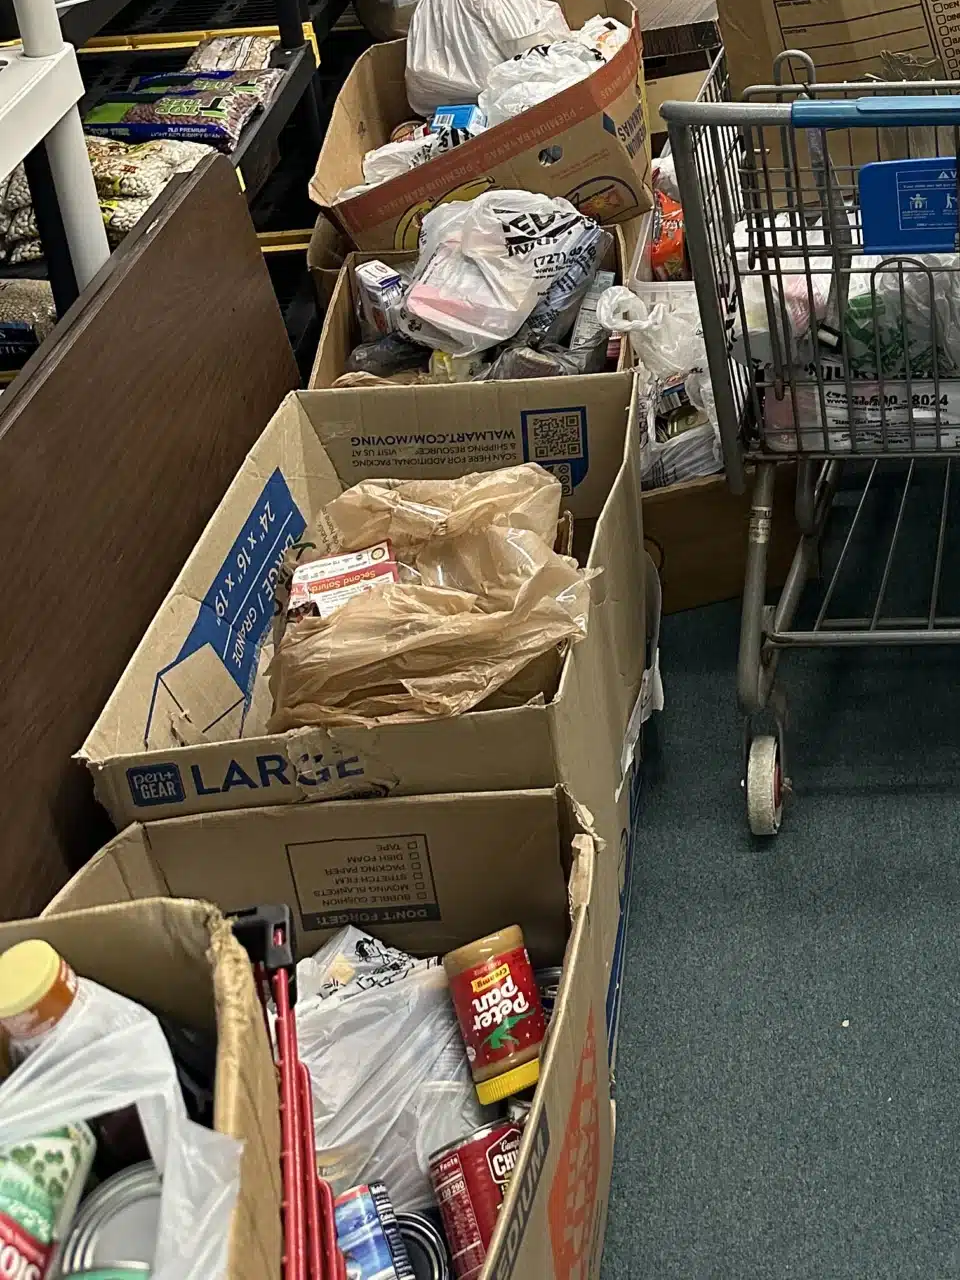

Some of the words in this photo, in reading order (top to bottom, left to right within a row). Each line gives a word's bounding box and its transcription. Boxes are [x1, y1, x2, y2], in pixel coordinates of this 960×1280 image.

[944, 0, 960, 10] DEN
[534, 252, 567, 268] (727)
[911, 394, 948, 406] 8024
[350, 429, 516, 447] WALMART.COM/MOVING
[351, 449, 362, 457] AT
[364, 449, 375, 457] US
[377, 448, 397, 456] VISIT
[467, 444, 509, 453] SHIPPING
[392, 458, 447, 466] ADDITIONAL
[447, 456, 466, 465] FOR
[467, 454, 491, 463] HERE
[492, 453, 517, 461] SCAN
[352, 459, 391, 468] PACKING
[343, 570, 376, 586] Second
[302, 579, 341, 595] Saturdy
[232, 606, 258, 669] GRANDE
[133, 771, 175, 790] pen+
[140, 782, 177, 799] GEAR
[376, 843, 401, 852] TAPE
[347, 855, 377, 864] FOAM
[379, 854, 404, 862] DISH
[360, 863, 405, 873] PACKING
[335, 876, 359, 885] FILM
[360, 873, 408, 883] STRETCH
[313, 886, 367, 897] BLANKETS
[368, 883, 409, 893] MOVING
[321, 896, 368, 906] CUSHION
[371, 893, 411, 903] BUBBLE
[316, 913, 378, 926] FORGET!
[383, 908, 428, 921] DON'T
[474, 965, 510, 992] Creamy
[471, 979, 519, 1013] pan
[473, 991, 530, 1031] Peter
[496, 1126, 547, 1280] EDIUM
